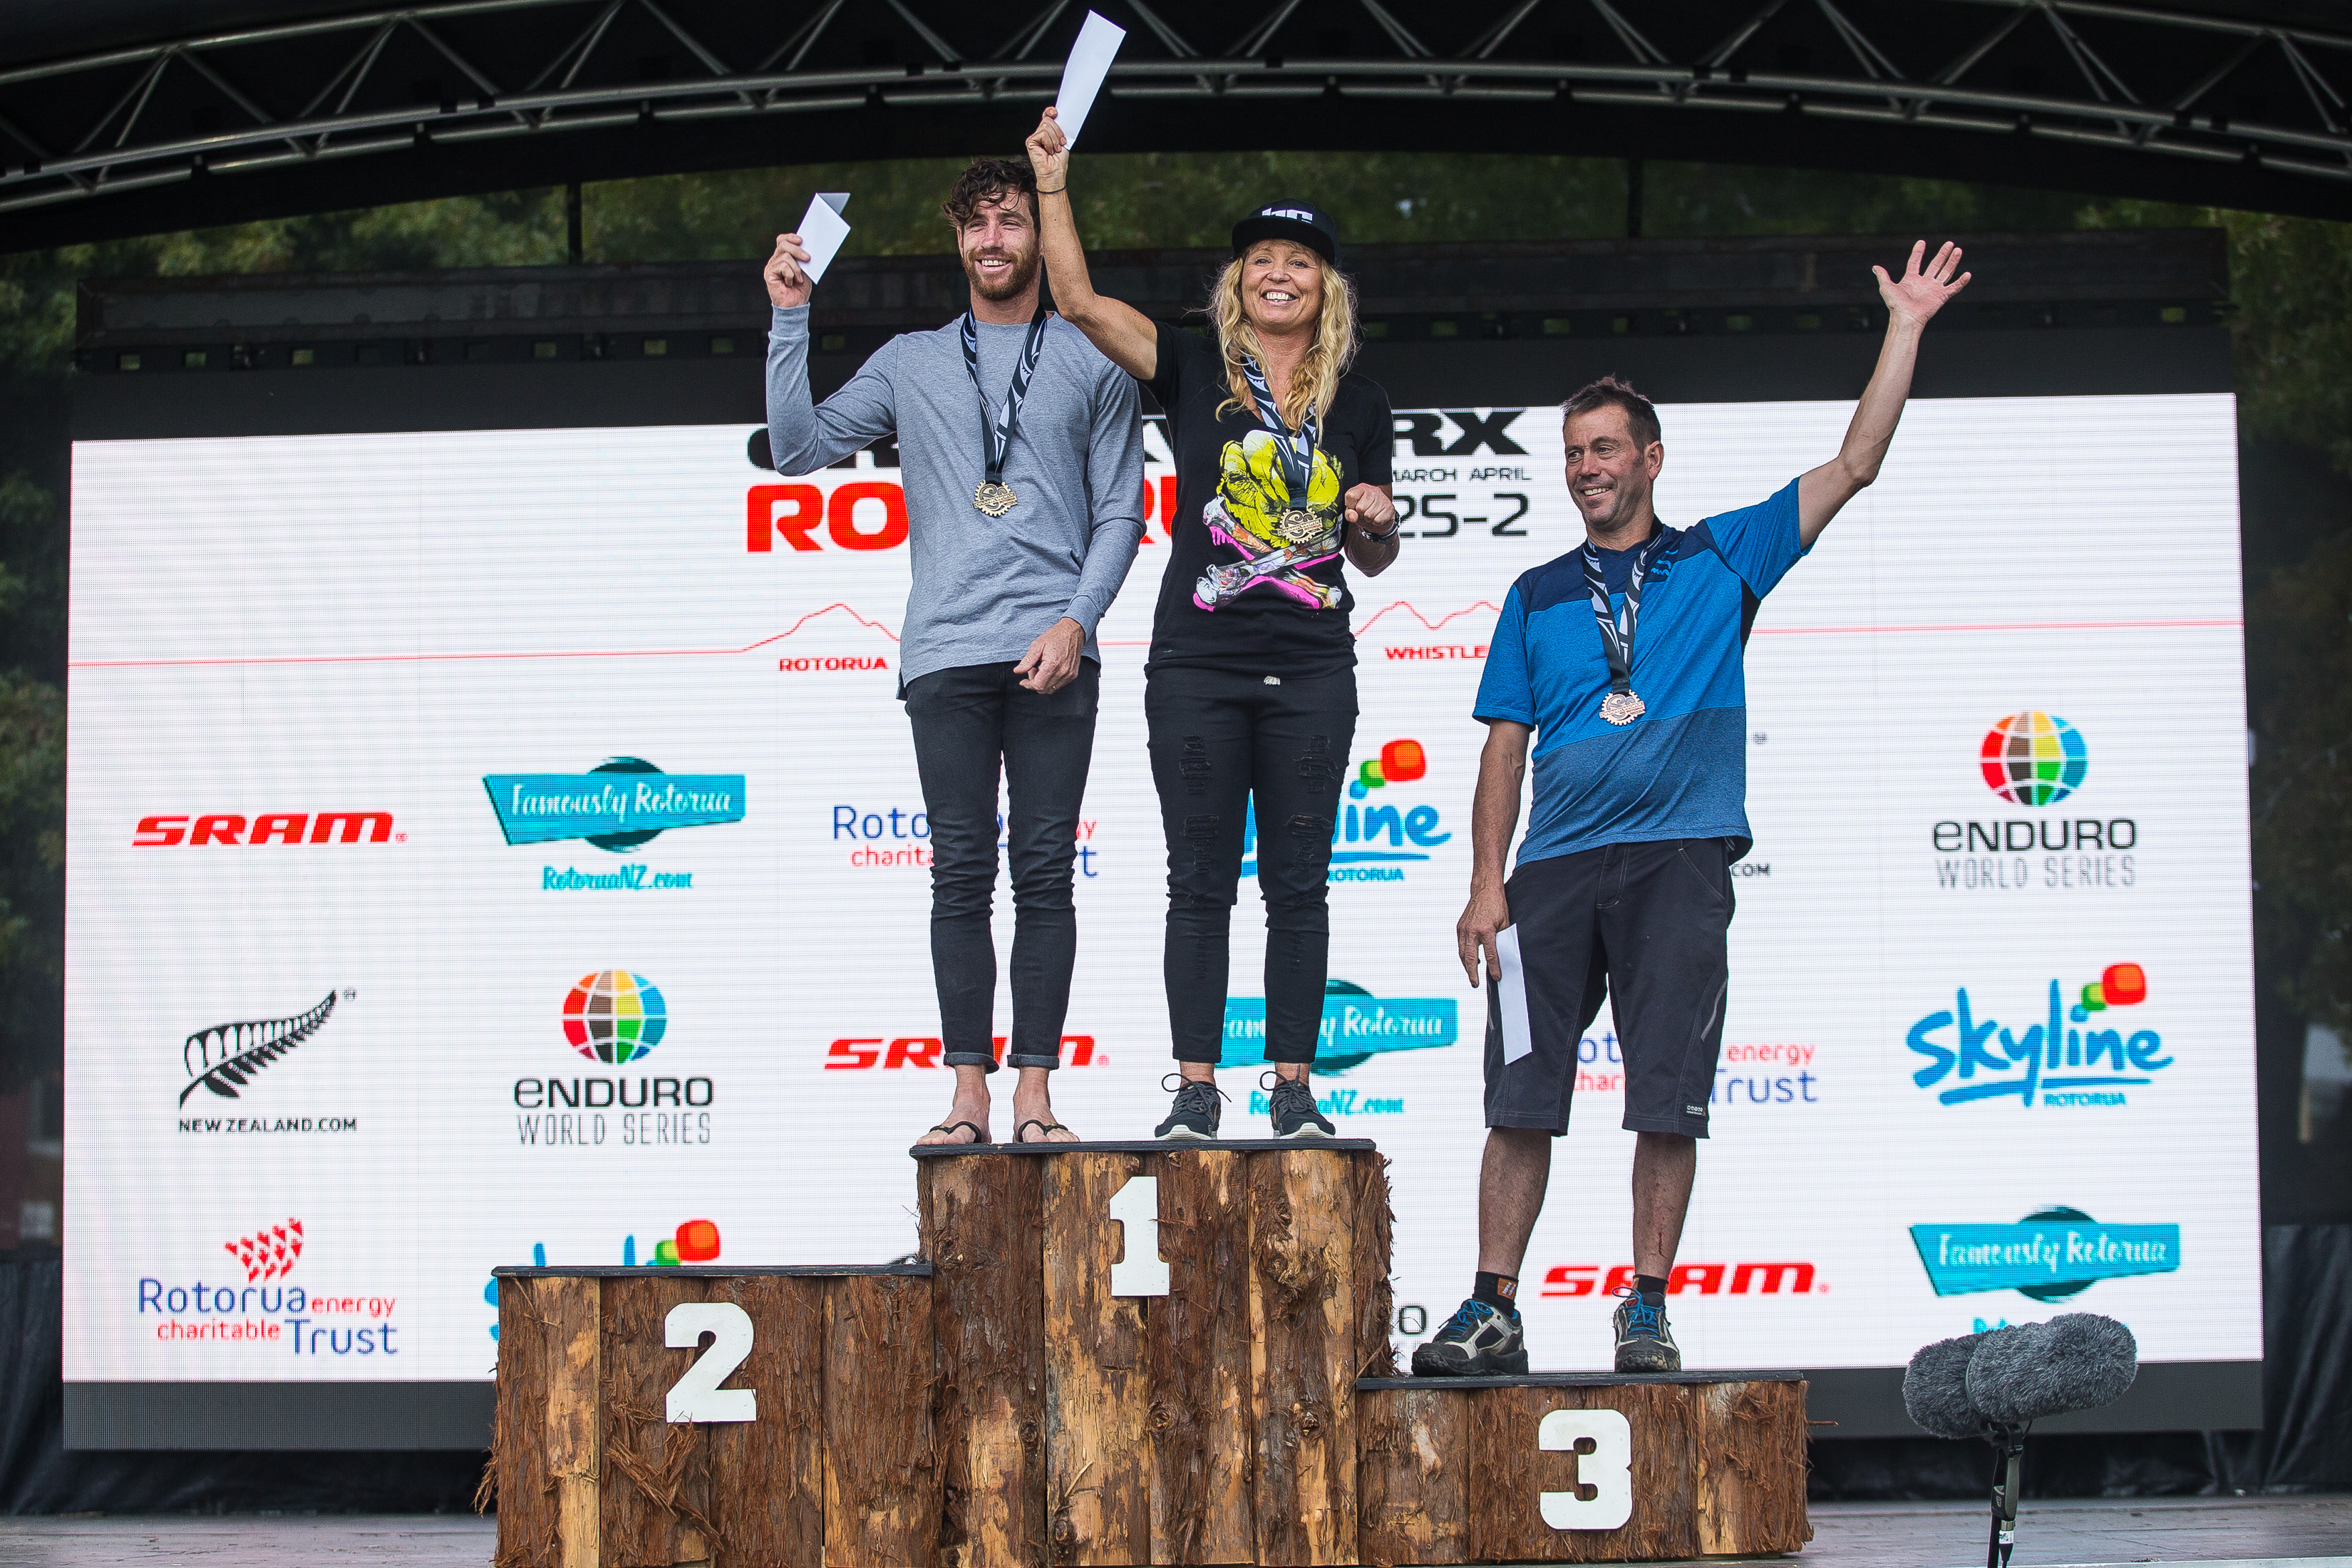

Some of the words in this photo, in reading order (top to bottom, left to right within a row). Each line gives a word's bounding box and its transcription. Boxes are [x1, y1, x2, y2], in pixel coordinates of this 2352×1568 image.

[1470, 467, 1532, 481] APRIL
[779, 656, 889, 671] ROTORUA
[1384, 644, 1489, 661] WHISTLE
[512, 783, 629, 824] Famously
[634, 781, 733, 814] Rotorua
[132, 811, 394, 847] SRAM
[832, 805, 931, 840] Roto
[1936, 857, 2028, 889] WORLD
[2044, 855, 2136, 888] SERIES
[1726, 1043, 1816, 1068] energy
[2045, 1093, 2125, 1106] ROTORUA
[518, 1114, 605, 1145] WORLD
[624, 1113, 711, 1145] SERIES
[1109, 1176, 1170, 1296] 1
[1939, 1232, 2060, 1273] Famously
[2068, 1231, 2167, 1263] Rotorua
[138, 1279, 307, 1314] Rotorua
[311, 1296, 397, 1319] energy
[158, 1319, 281, 1341] charitable
[285, 1319, 398, 1355] Trust
[665, 1302, 757, 1423] 2
[1539, 1408, 1633, 1530] 3
